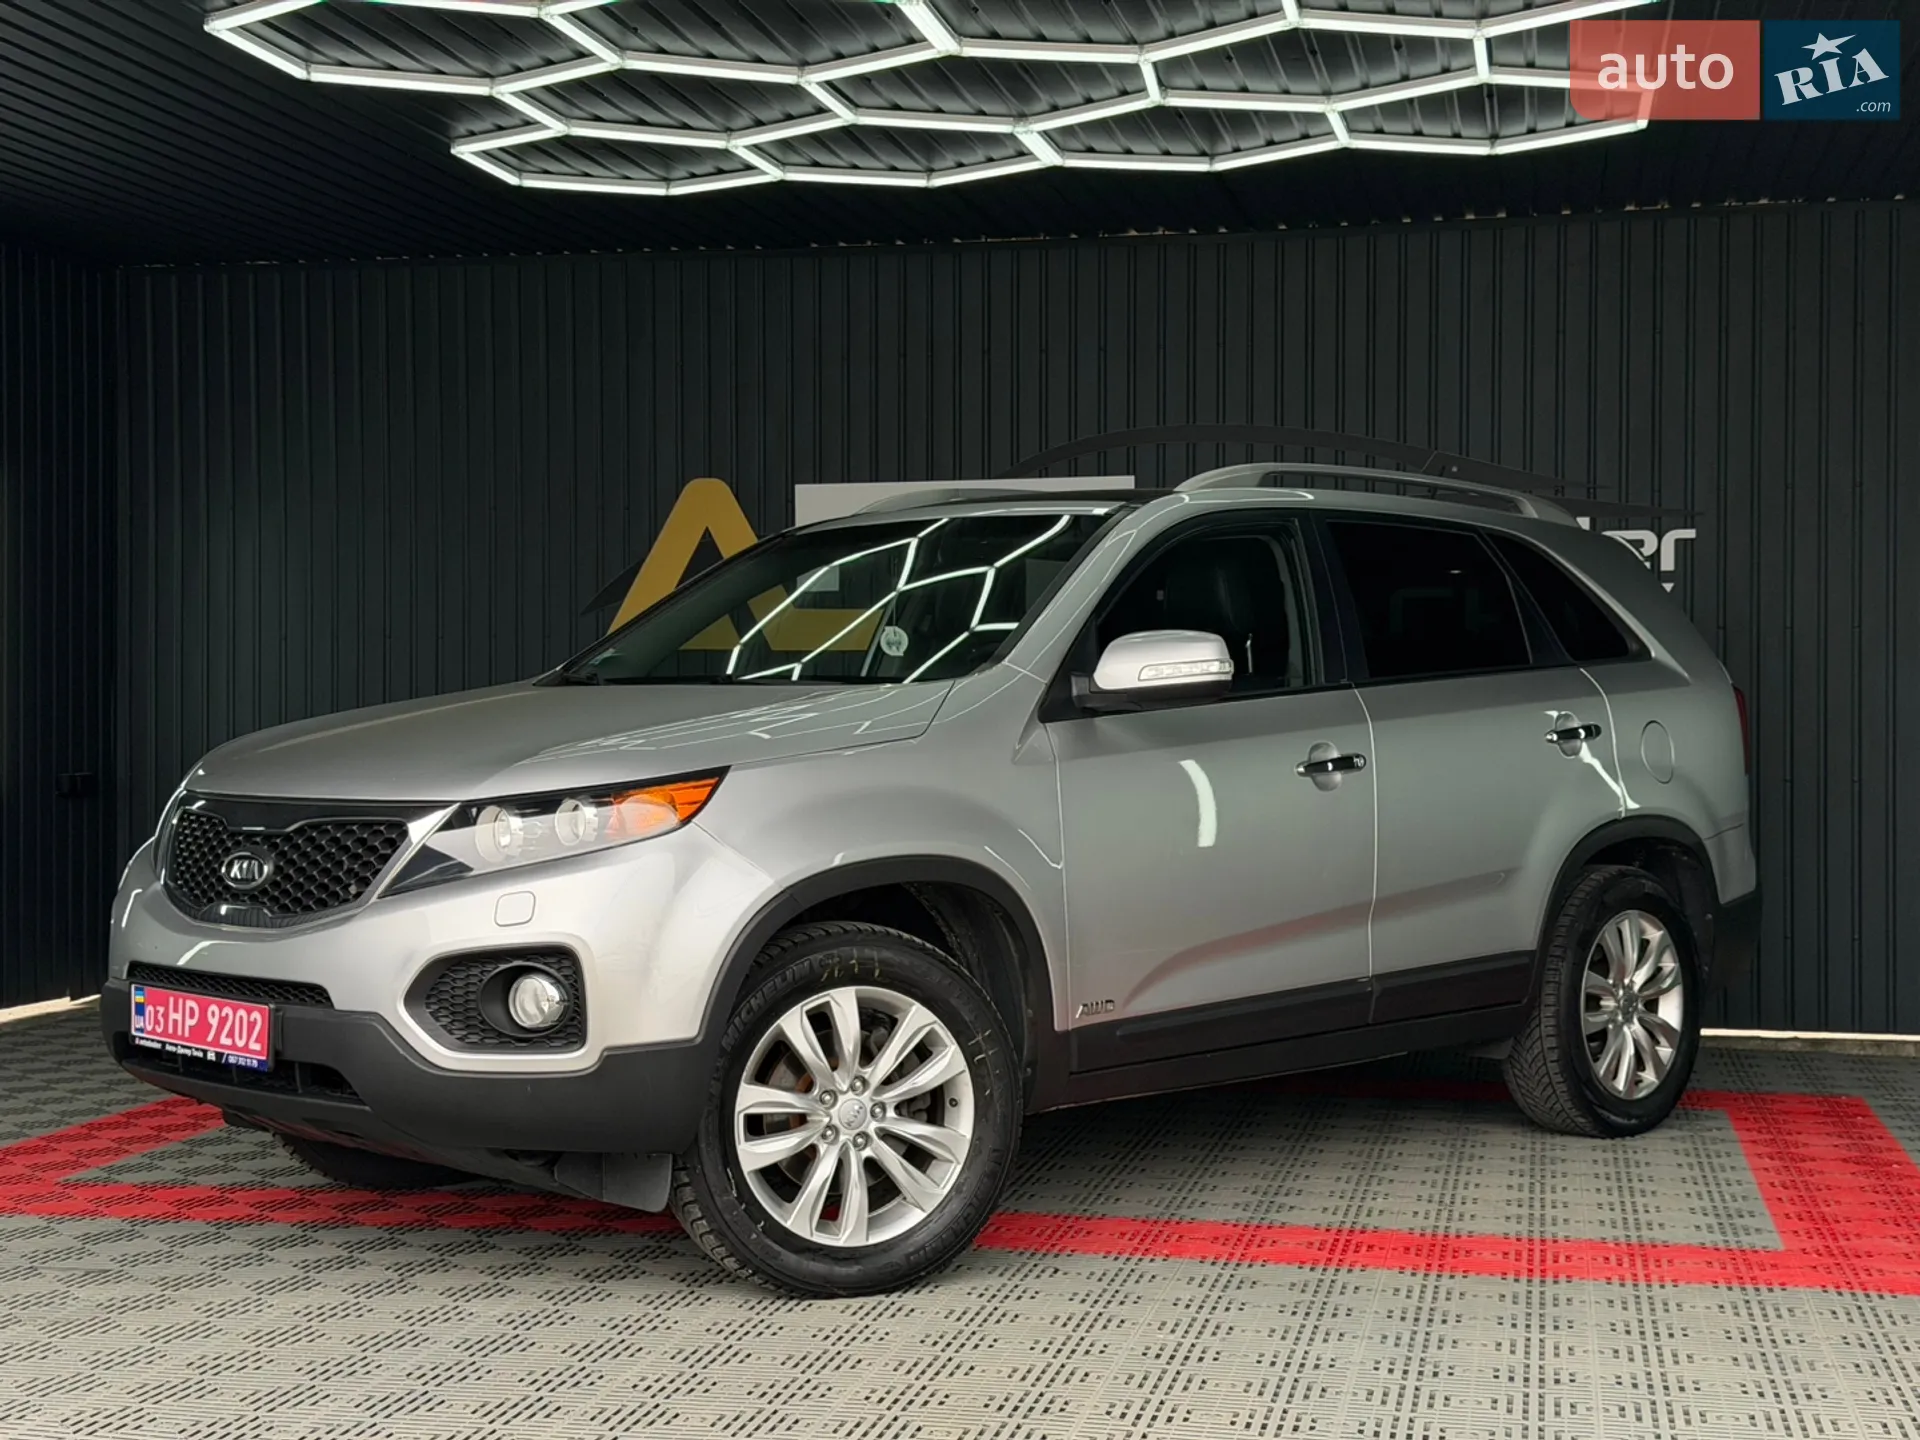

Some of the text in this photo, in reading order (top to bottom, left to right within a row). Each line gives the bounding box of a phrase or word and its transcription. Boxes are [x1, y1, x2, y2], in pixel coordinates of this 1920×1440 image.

[230, 859, 259, 879] KIA
[721, 957, 812, 1053] MICHELIN
[1075, 999, 1115, 1019] AWD
[206, 1003, 262, 1051] 9202
